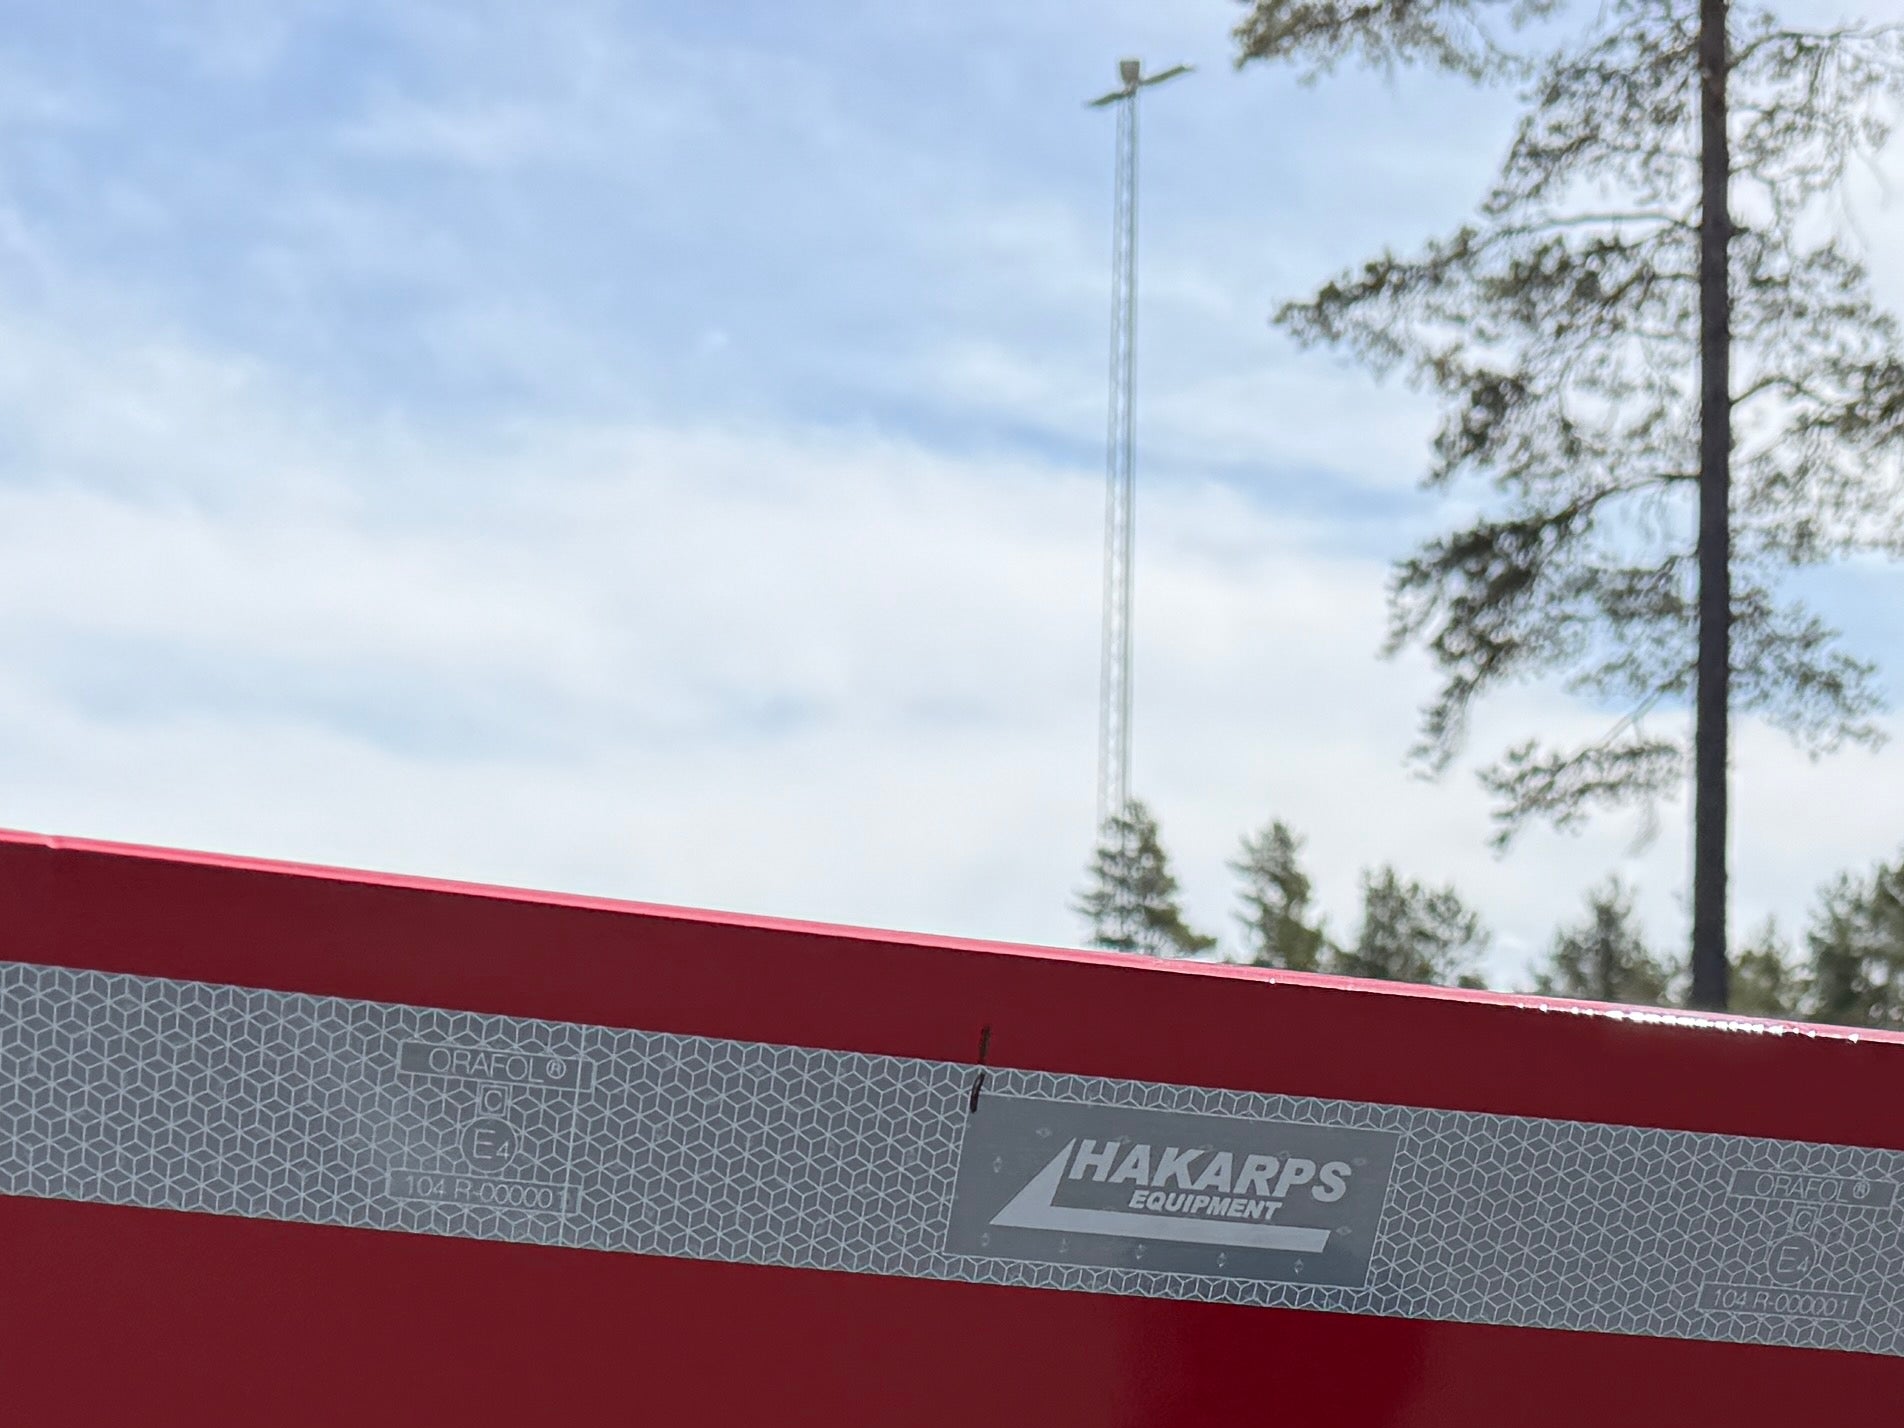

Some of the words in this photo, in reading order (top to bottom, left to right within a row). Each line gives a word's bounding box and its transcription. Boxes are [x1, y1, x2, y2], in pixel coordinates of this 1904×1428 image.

[1069, 1138, 1352, 1203] HAKARPS
[406, 1175, 446, 1198] 104
[1128, 1189, 1283, 1221] EQUIPMENT
[1714, 1288, 1748, 1308] 104
